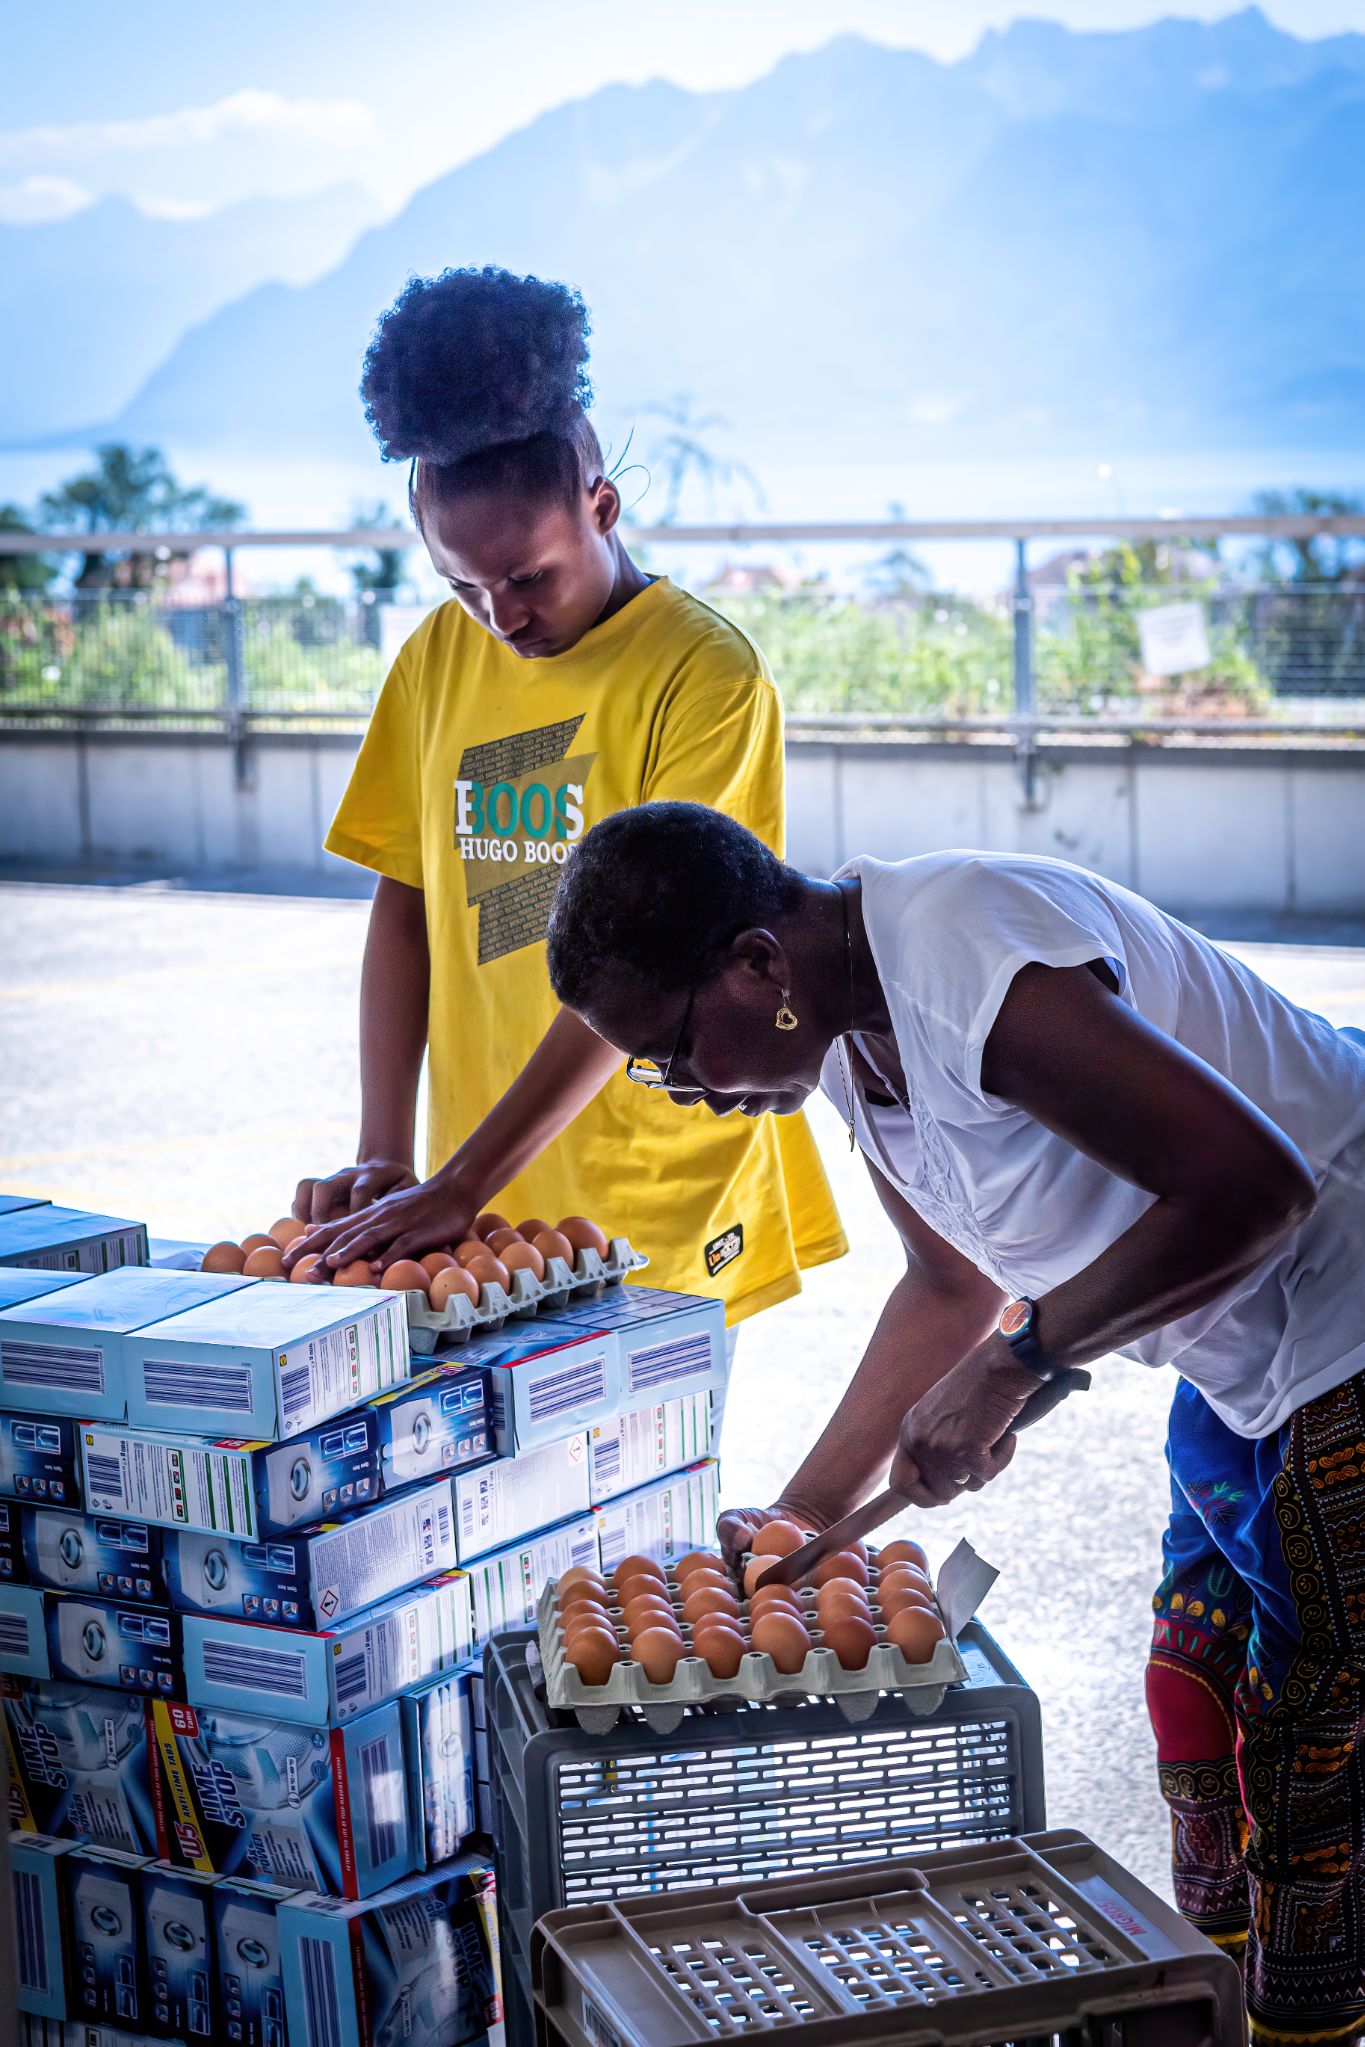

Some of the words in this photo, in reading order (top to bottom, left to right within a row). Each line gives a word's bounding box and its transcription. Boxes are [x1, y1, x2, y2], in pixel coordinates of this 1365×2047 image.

[454, 780, 584, 840] BOOS
[459, 837, 518, 862] HUGO
[172, 1708, 187, 1730] 60
[16, 1723, 48, 1783] LIME
[34, 1721, 69, 1791] STOP
[164, 1743, 177, 1766] TABS
[171, 1769, 192, 1818] ANTI-LIME
[191, 1761, 226, 1823] LIME
[210, 1759, 247, 1829] STOP
[174, 1820, 205, 1860] W5
[251, 1833, 273, 1875] POWER
